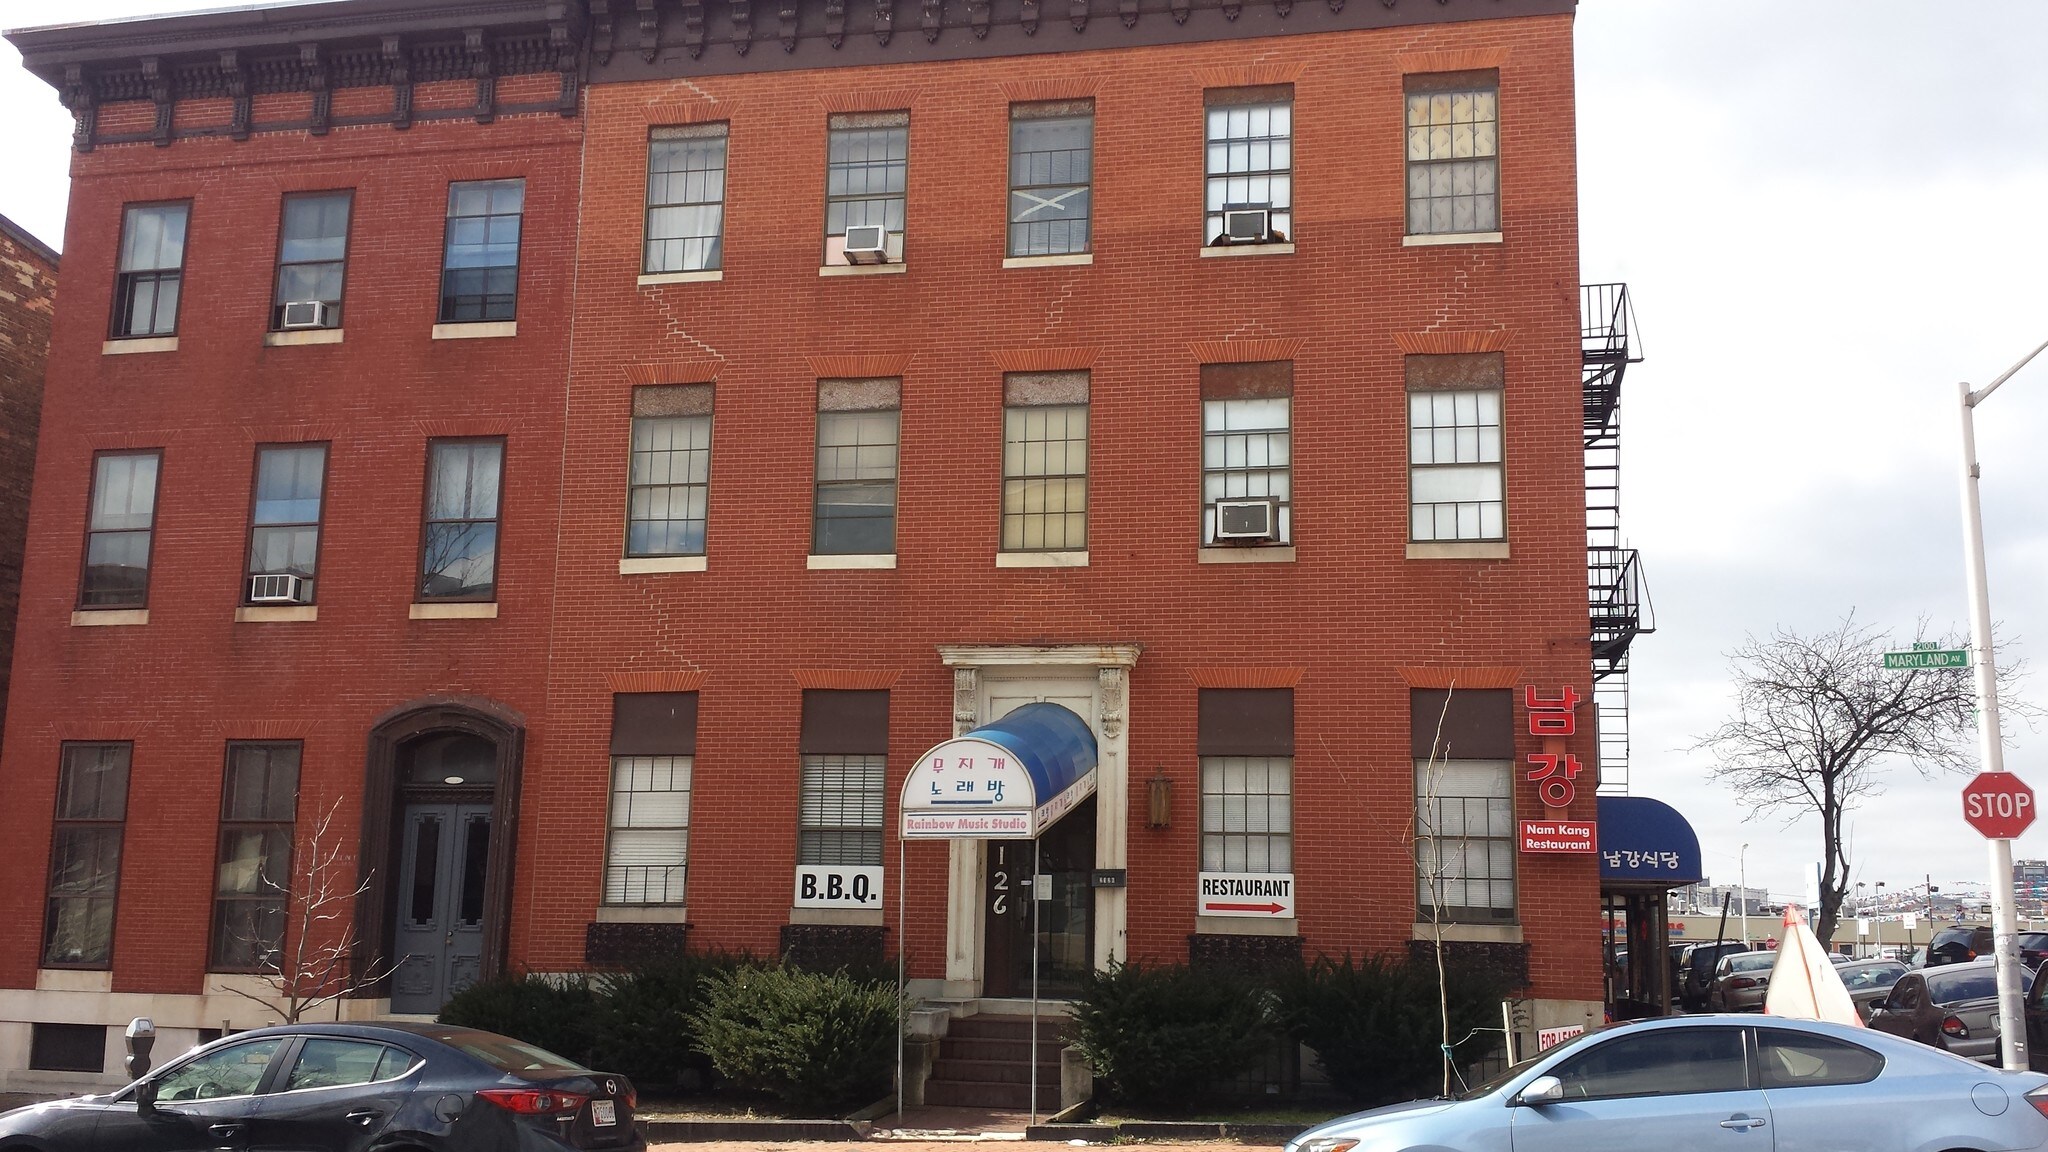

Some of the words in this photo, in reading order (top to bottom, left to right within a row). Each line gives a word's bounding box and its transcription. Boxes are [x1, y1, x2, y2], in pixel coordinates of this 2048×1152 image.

[1916, 642, 1935, 650] 2100
[1888, 653, 1949, 667] MARYLAND
[1968, 792, 2031, 819] STOP
[907, 818, 955, 830] Rainbow
[957, 818, 989, 830] Music
[991, 818, 1027, 830] Studio
[1526, 824, 1555, 835] Nam
[1558, 824, 1590, 838] Kang
[1526, 838, 1591, 850] Restaurant
[1603, 850, 1679, 870] 남강식당
[801, 873, 877, 903] B.B.Q.
[993, 846, 1009, 915] 126
[1202, 878, 1290, 897] RESTAURANT
[1541, 1033, 1557, 1050] FOR
